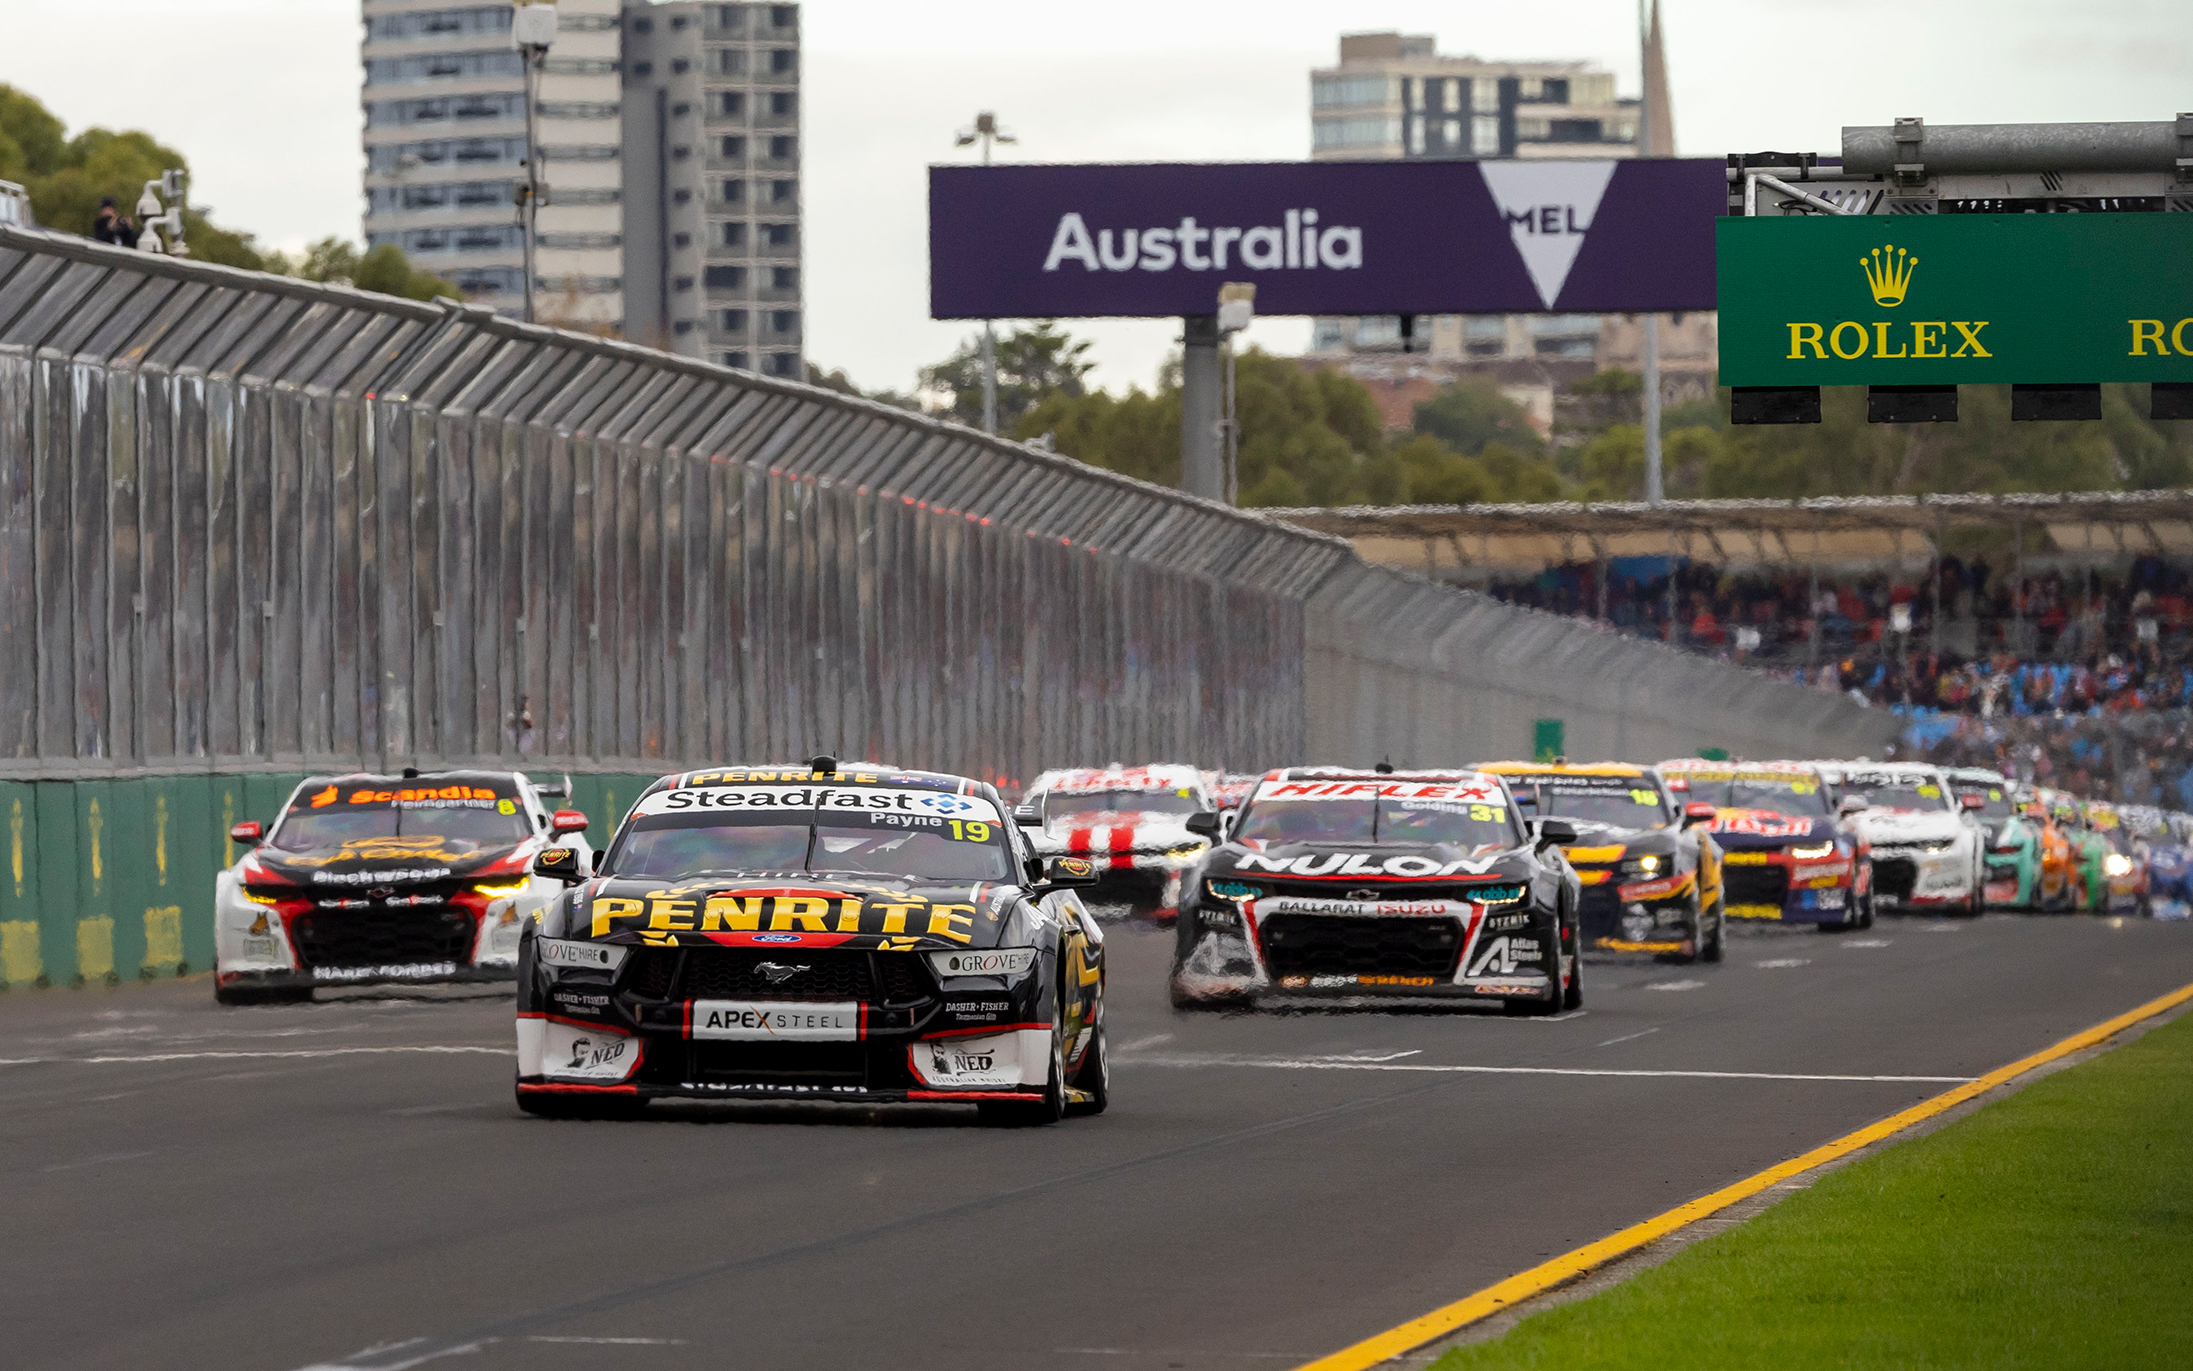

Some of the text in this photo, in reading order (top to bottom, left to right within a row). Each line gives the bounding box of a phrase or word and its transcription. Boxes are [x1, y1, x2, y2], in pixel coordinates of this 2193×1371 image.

[1507, 206, 1588, 235] MEL
[1043, 208, 1363, 272] Australia
[1786, 321, 1993, 359] ROLEX
[692, 771, 878, 785] PENRITE
[349, 786, 496, 803] Scandia
[665, 790, 912, 810] Steadfast
[1269, 783, 1486, 801] HIFLEX
[497, 799, 516, 815] 8
[1401, 801, 1506, 823] Golding 31
[871, 812, 990, 842] Payne 19
[1234, 854, 1500, 876] NULON
[1279, 901, 1447, 916] BALLARAT ISUZU
[591, 896, 976, 944] PENRITE
[1511, 938, 1539, 949] Atlas
[579, 947, 598, 961] HIRE
[962, 955, 1016, 971] GROVE
[945, 1001, 1009, 1012] DASHER FISHER
[706, 1005, 843, 1031] APEX STEEL
[591, 1042, 625, 1064] NED
[954, 1055, 993, 1071] NED
